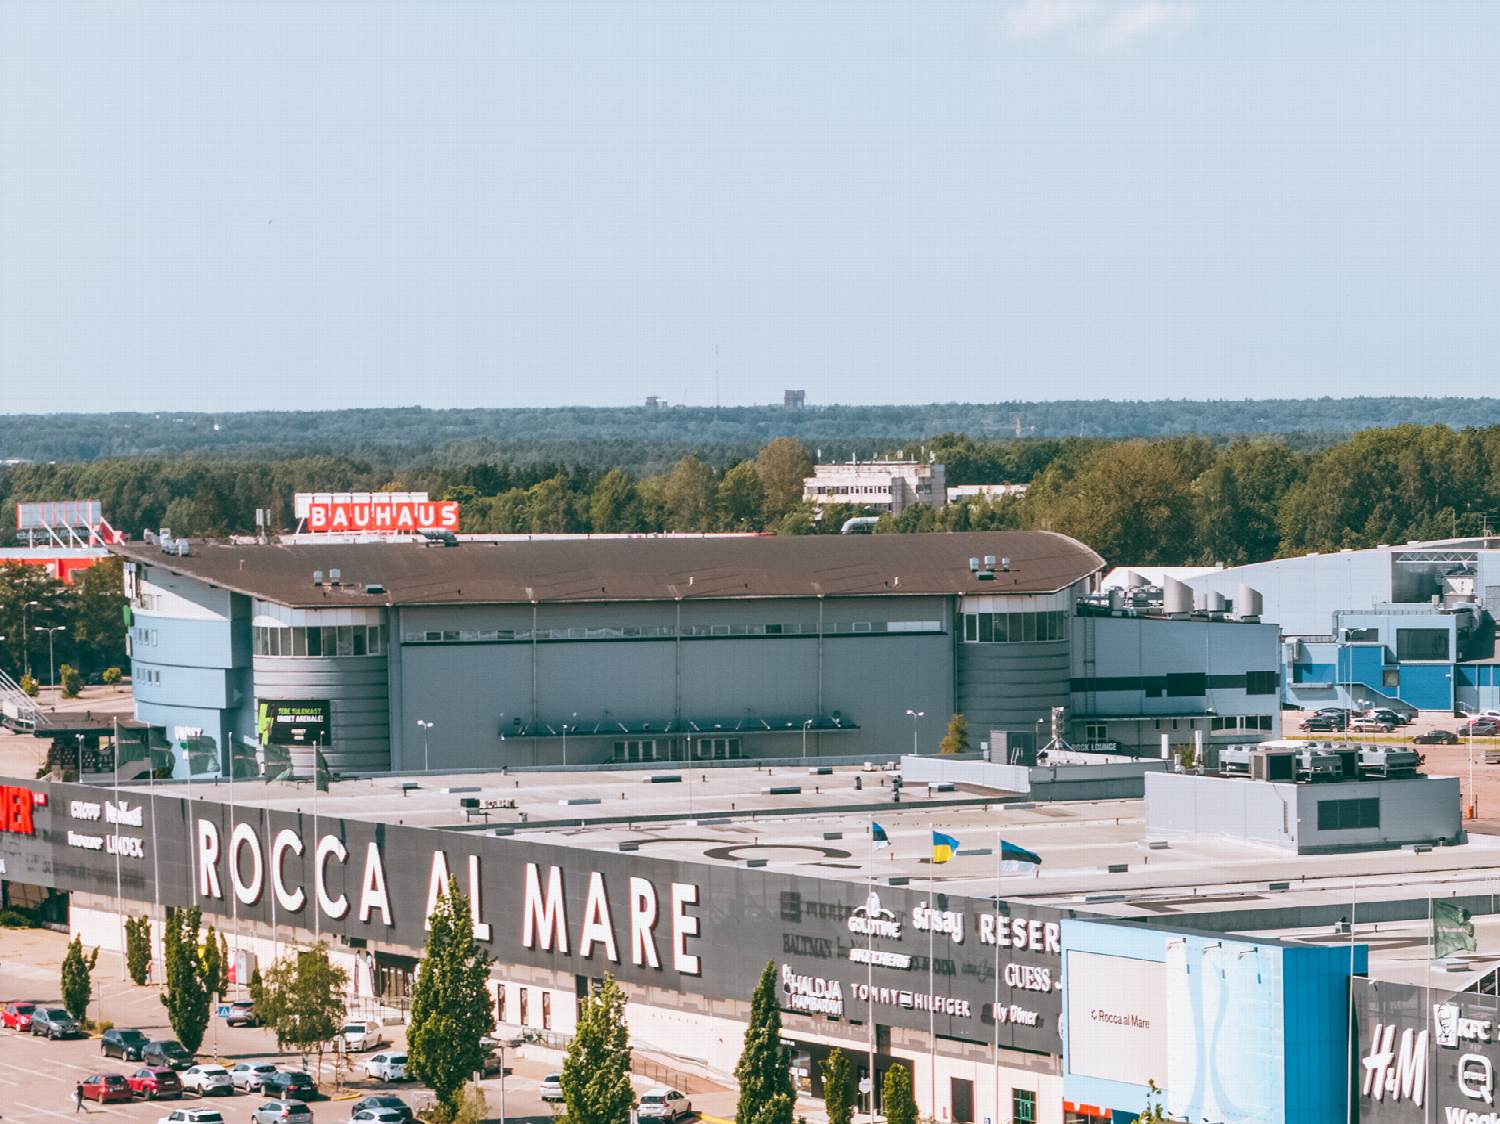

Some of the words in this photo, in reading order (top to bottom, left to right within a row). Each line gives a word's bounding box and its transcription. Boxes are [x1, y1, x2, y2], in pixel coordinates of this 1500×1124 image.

[311, 504, 458, 526] BAUHAUS
[198, 818, 393, 926] ROCCA
[424, 850, 490, 941] AL
[523, 863, 700, 975] MARE
[912, 901, 964, 943] sinsay
[980, 913, 1061, 953] RESER
[1005, 963, 1051, 992] GUESS
[851, 983, 900, 1007] TOMMY
[914, 993, 971, 1017] HILFIGER
[1098, 1010, 1122, 1025] Rocca
[1123, 1014, 1130, 1026] al
[1131, 1014, 1150, 1029] Mare
[1457, 1018, 1491, 1041] KFC
[1362, 1023, 1428, 1107] H&M
